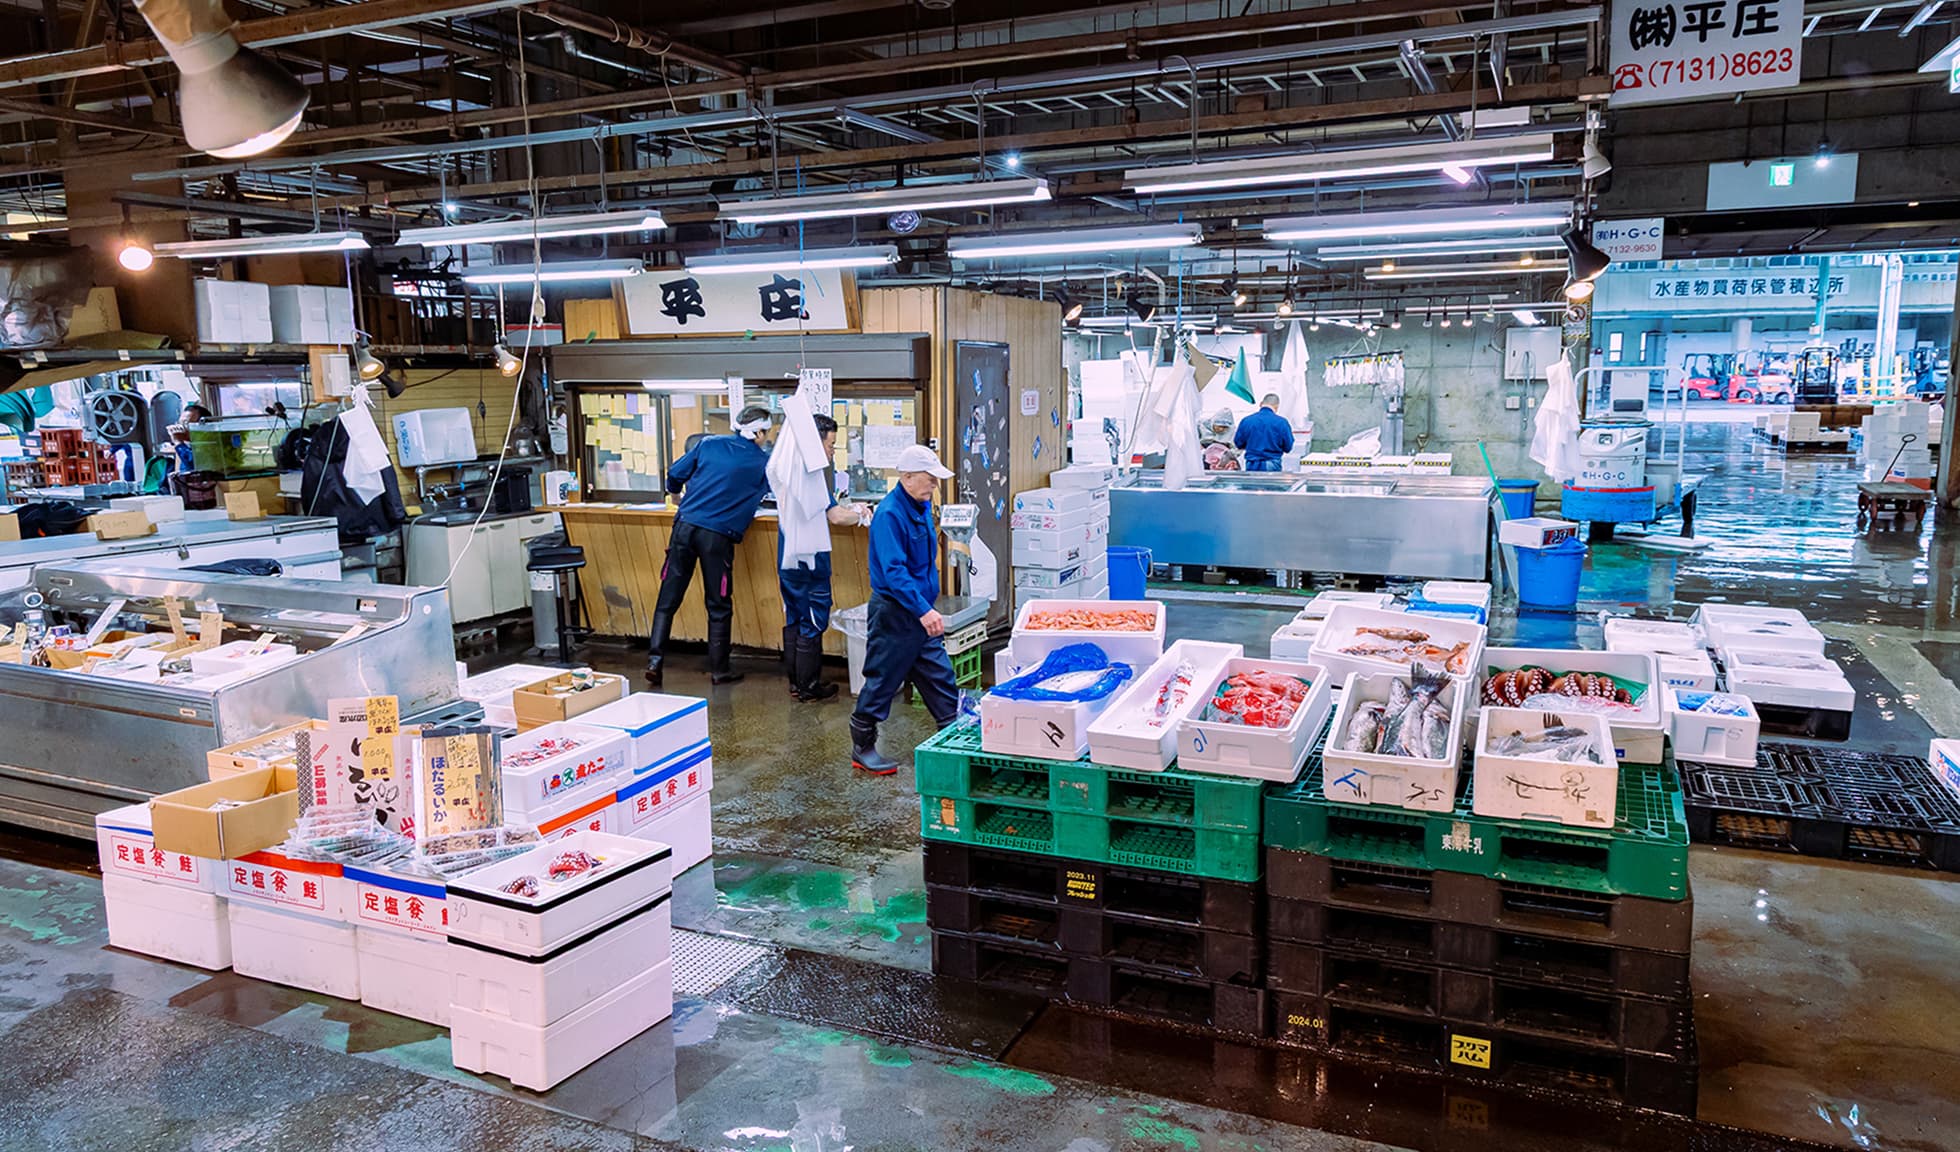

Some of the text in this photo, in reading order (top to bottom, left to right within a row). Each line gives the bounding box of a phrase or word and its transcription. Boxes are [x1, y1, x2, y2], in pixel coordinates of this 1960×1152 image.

[1648, 47, 1793, 88] (7131)8623
[431, 756, 448, 823] ほたるいか
[1287, 1014, 1324, 1029] 2024.01
